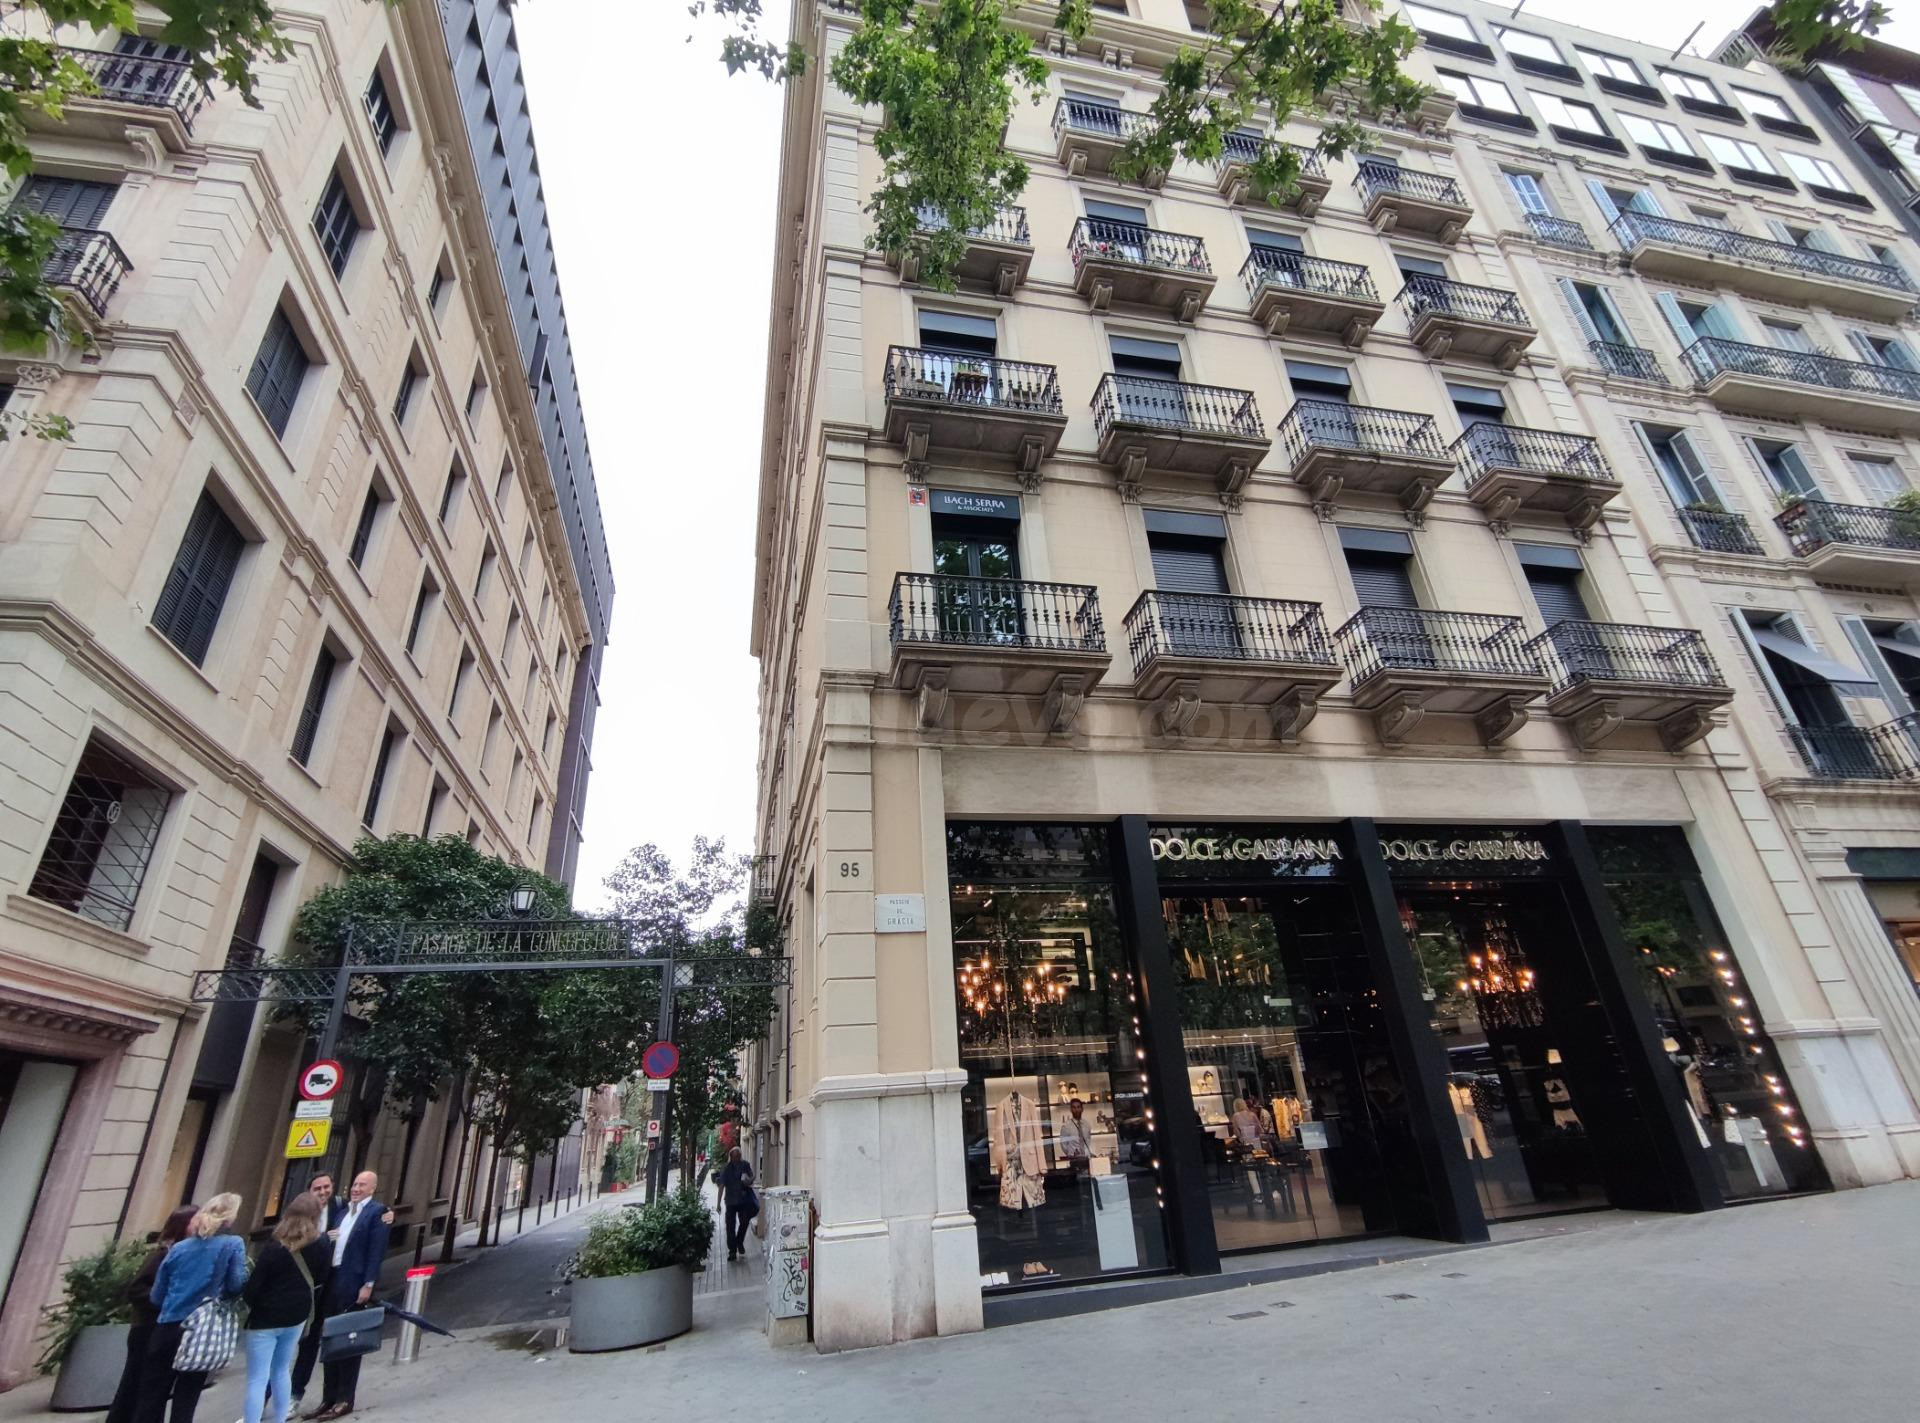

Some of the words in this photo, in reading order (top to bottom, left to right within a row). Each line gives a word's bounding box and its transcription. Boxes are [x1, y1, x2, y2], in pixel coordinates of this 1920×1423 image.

[963, 505, 994, 513] ASSOCIATS
[975, 498, 1005, 509] SERRA
[840, 862, 860, 878] 95
[475, 931, 495, 954] DE
[502, 931, 521, 953] LA
